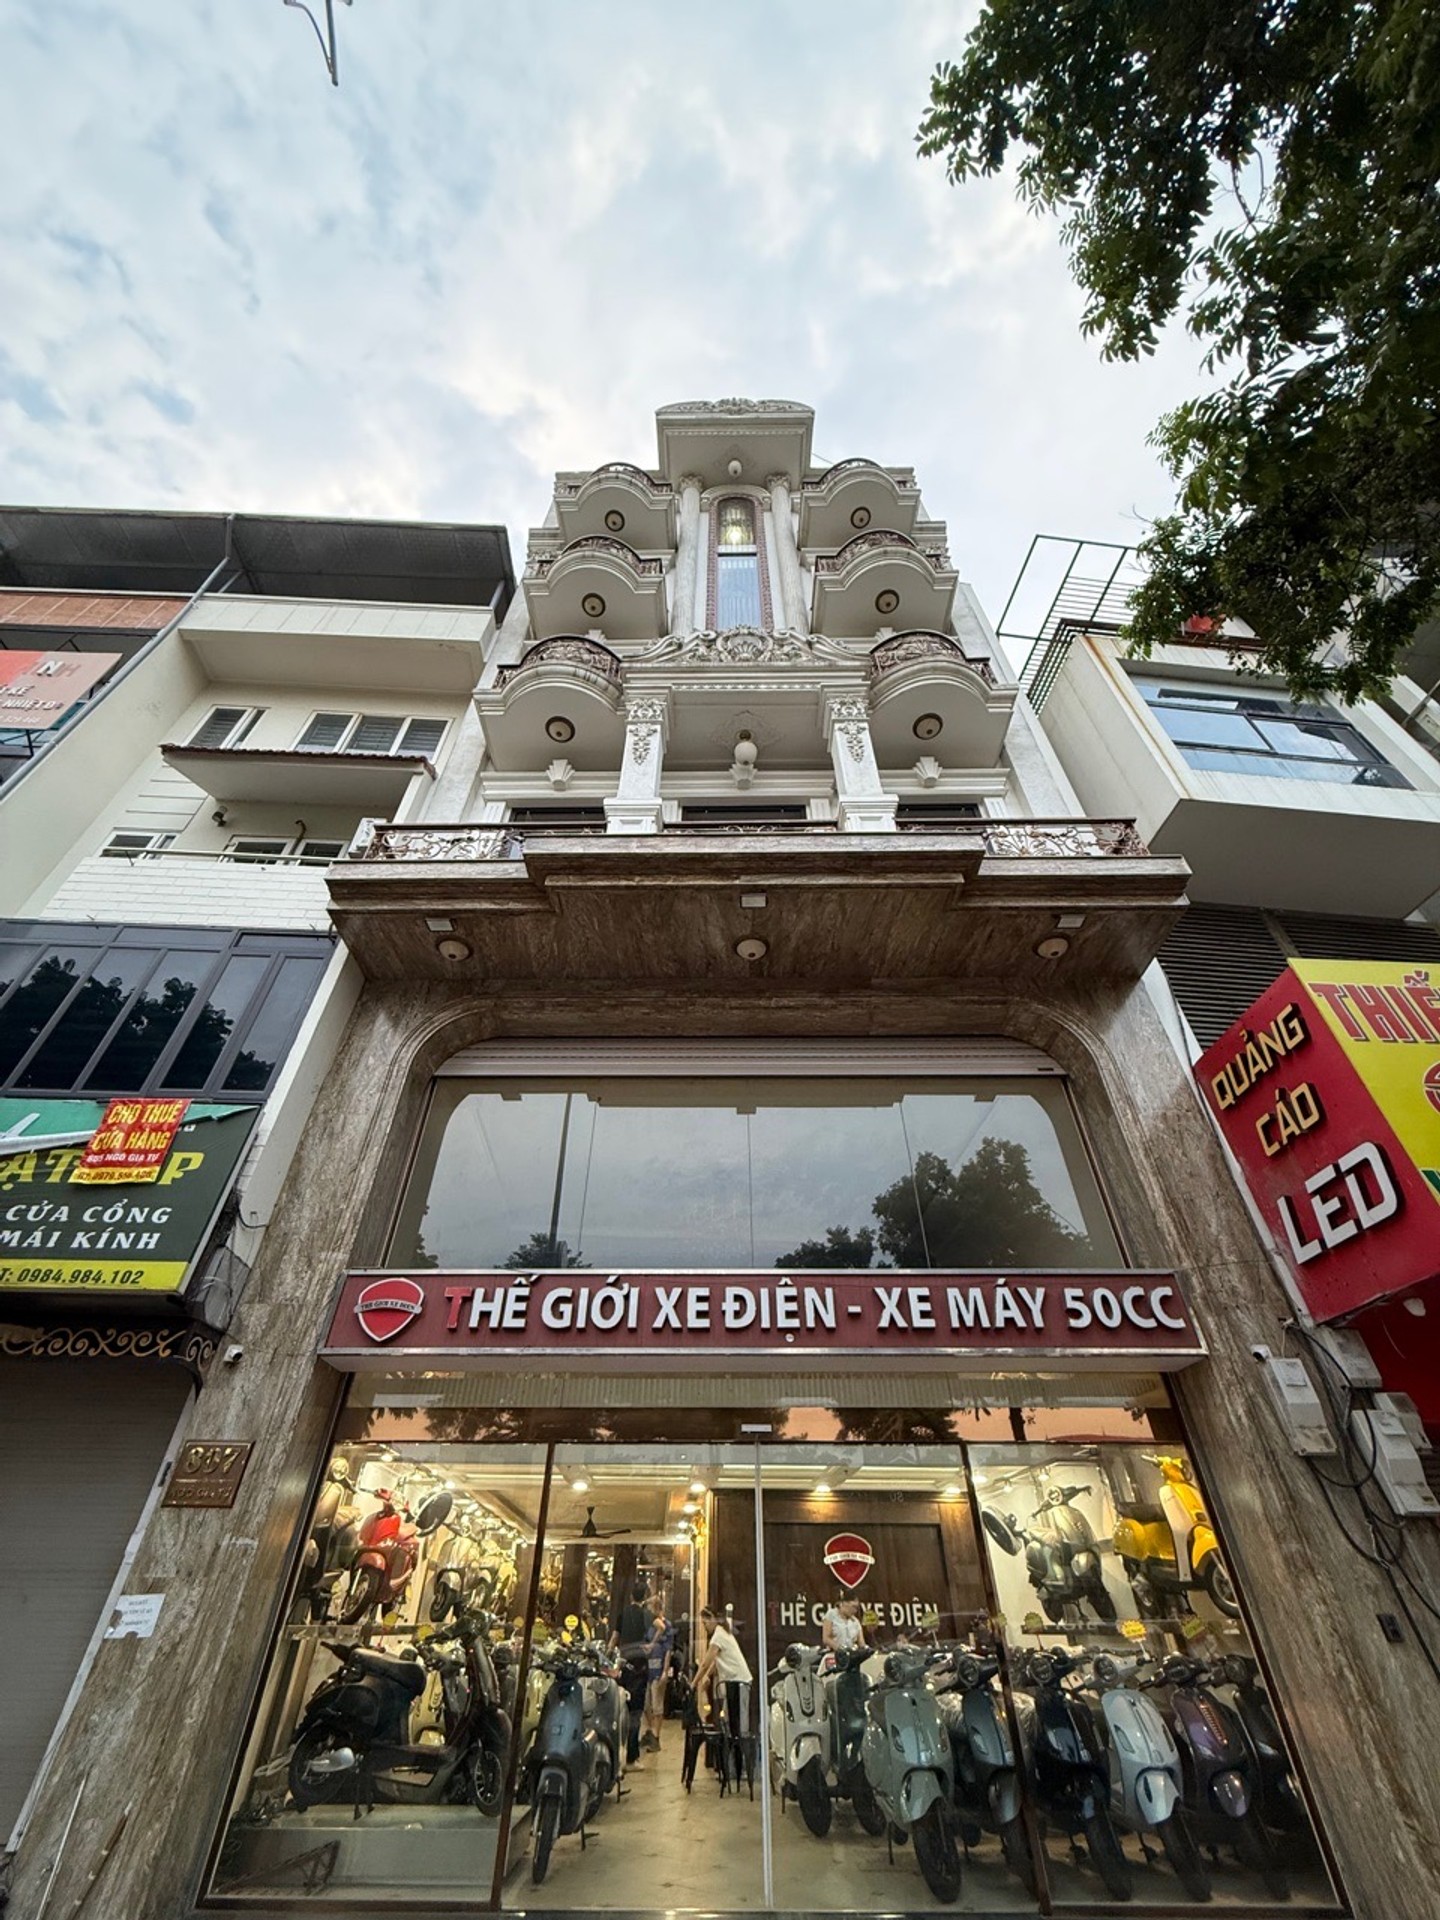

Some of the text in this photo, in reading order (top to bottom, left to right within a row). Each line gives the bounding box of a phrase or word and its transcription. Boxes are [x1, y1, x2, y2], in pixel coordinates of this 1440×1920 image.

[1211, 1003, 1305, 1111] QUẢNG
[107, 1104, 142, 1124] CHO
[1255, 1082, 1321, 1157] CÁO
[5, 1199, 172, 1224] CỬA CỔNG
[1276, 1141, 1398, 1265] LED
[0, 1226, 161, 1249] MÁI KÍNH
[17, 1268, 144, 1284] 0984.984.102
[444, 1275, 538, 1330] THẾ
[541, 1275, 638, 1330] GIỚI
[651, 1287, 711, 1330] XE
[721, 1277, 836, 1342] ĐIỆN
[874, 1286, 936, 1330] XE
[946, 1278, 1045, 1330] MÁY
[1065, 1286, 1186, 1330] 50CC
